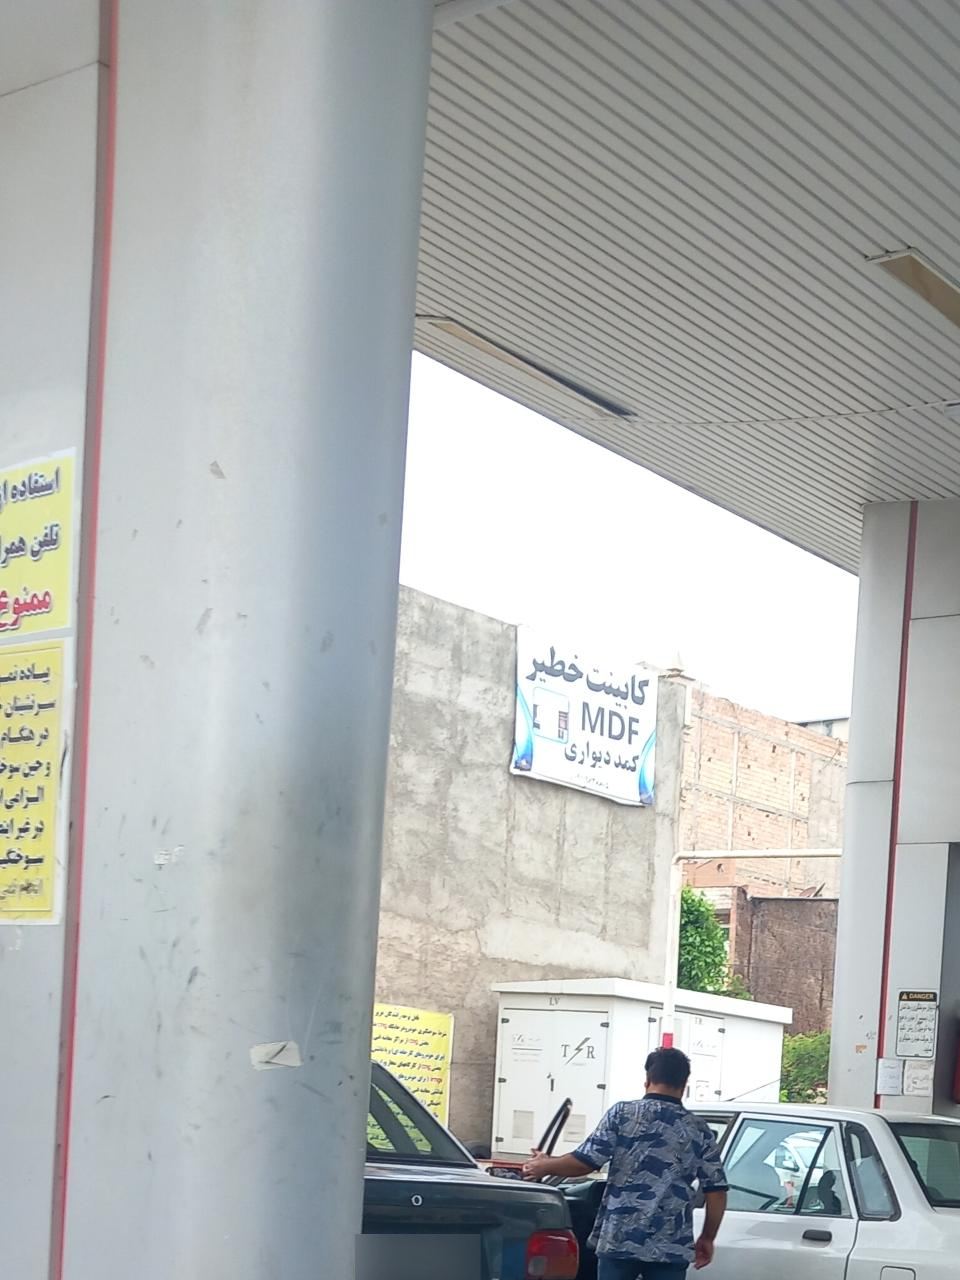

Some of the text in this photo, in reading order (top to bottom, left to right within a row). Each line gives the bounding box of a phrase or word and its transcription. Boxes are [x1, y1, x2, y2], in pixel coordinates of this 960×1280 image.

[11, 467, 60, 501] استفاده
[30, 524, 61, 559] تلفن
[525, 645, 650, 710] کابینت خطیر
[36, 727, 49, 748] در
[581, 701, 640, 745] MDF
[564, 740, 640, 773] کمد دیواری
[32, 819, 45, 840] در
